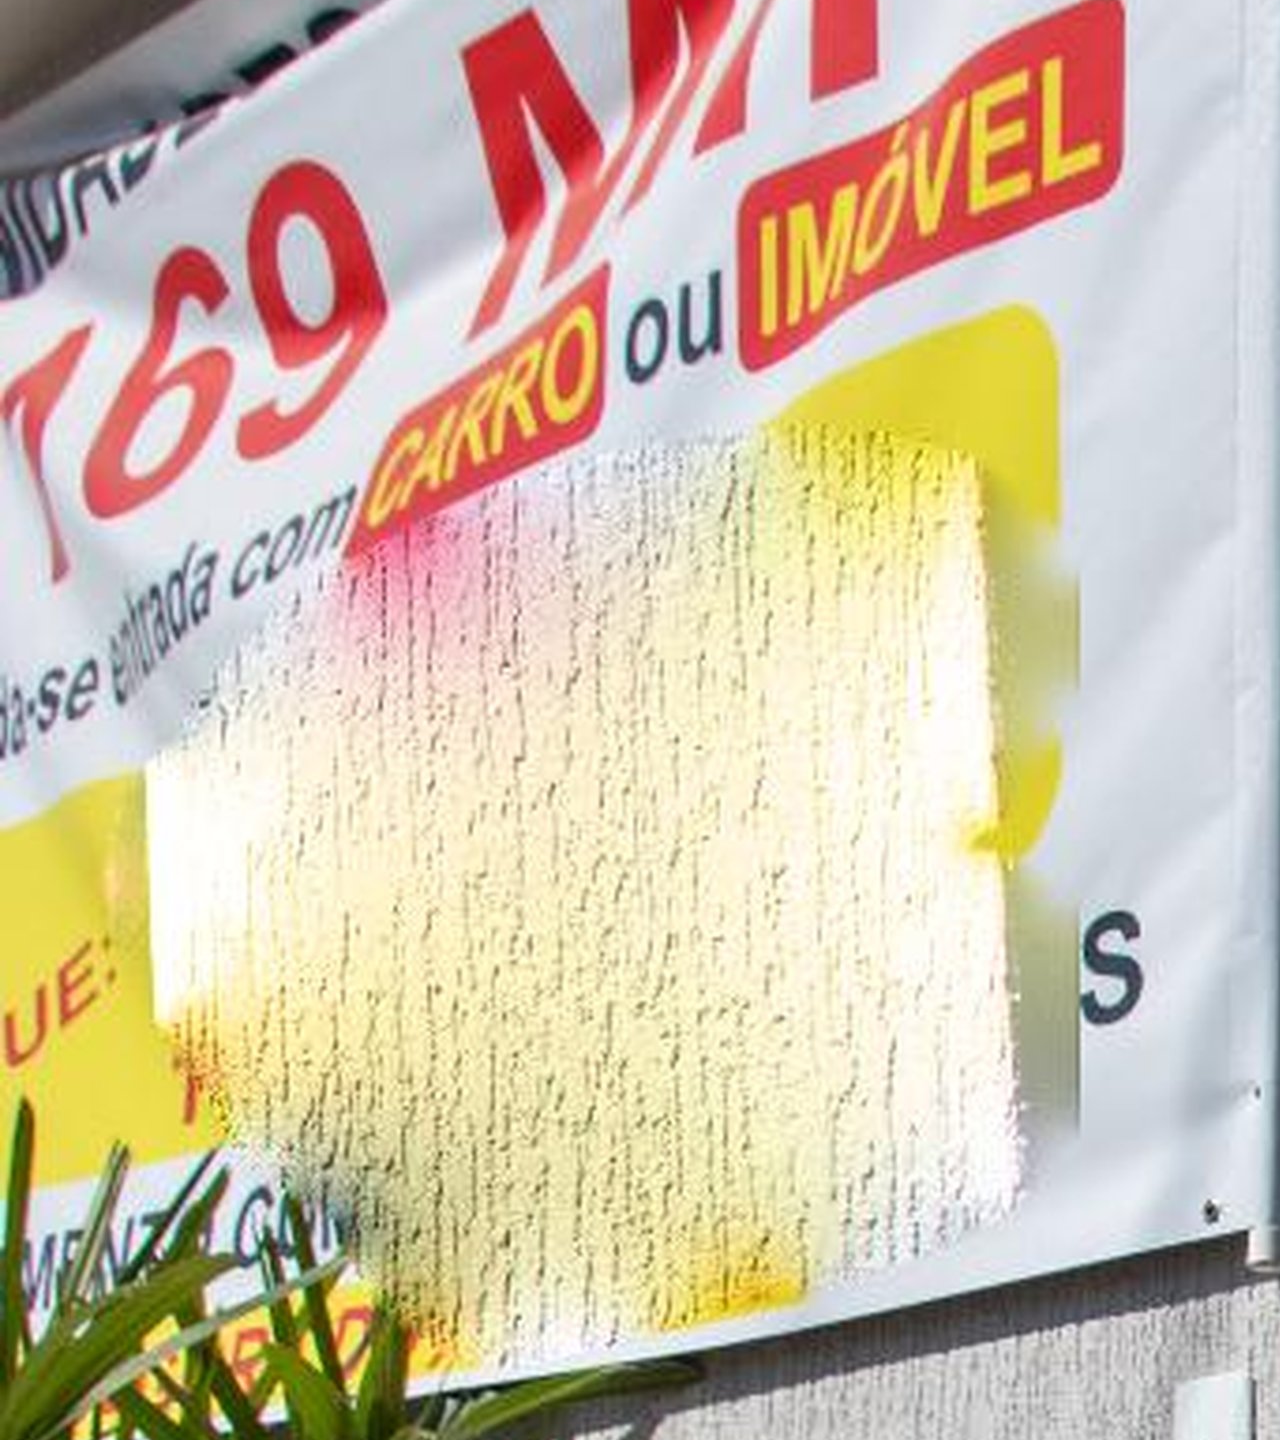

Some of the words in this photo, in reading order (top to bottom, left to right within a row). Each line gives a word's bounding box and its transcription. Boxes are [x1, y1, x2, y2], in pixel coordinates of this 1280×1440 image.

[109, 540, 220, 706] entrada
[230, 483, 358, 600] com
[363, 305, 598, 530] CARRO
[624, 270, 722, 385] ou
[759, 55, 1103, 338] IMÓVEL
